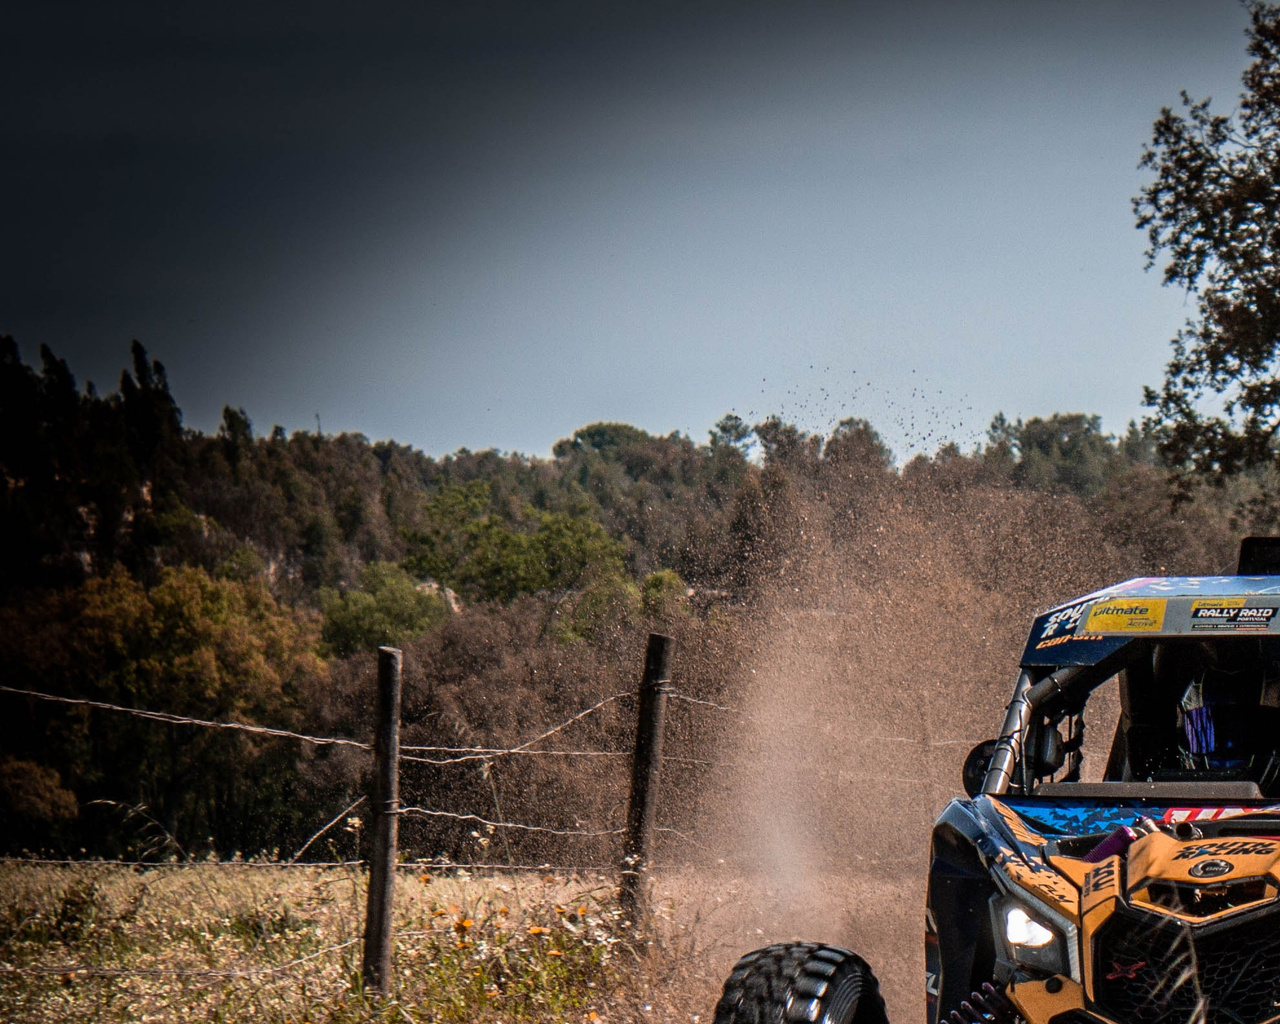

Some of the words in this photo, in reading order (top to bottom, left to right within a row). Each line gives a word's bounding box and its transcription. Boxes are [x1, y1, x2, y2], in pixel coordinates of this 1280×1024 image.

[1197, 608, 1238, 617] RALLY
[1239, 608, 1273, 617] RAID
[1177, 841, 1277, 853] SOUTH
